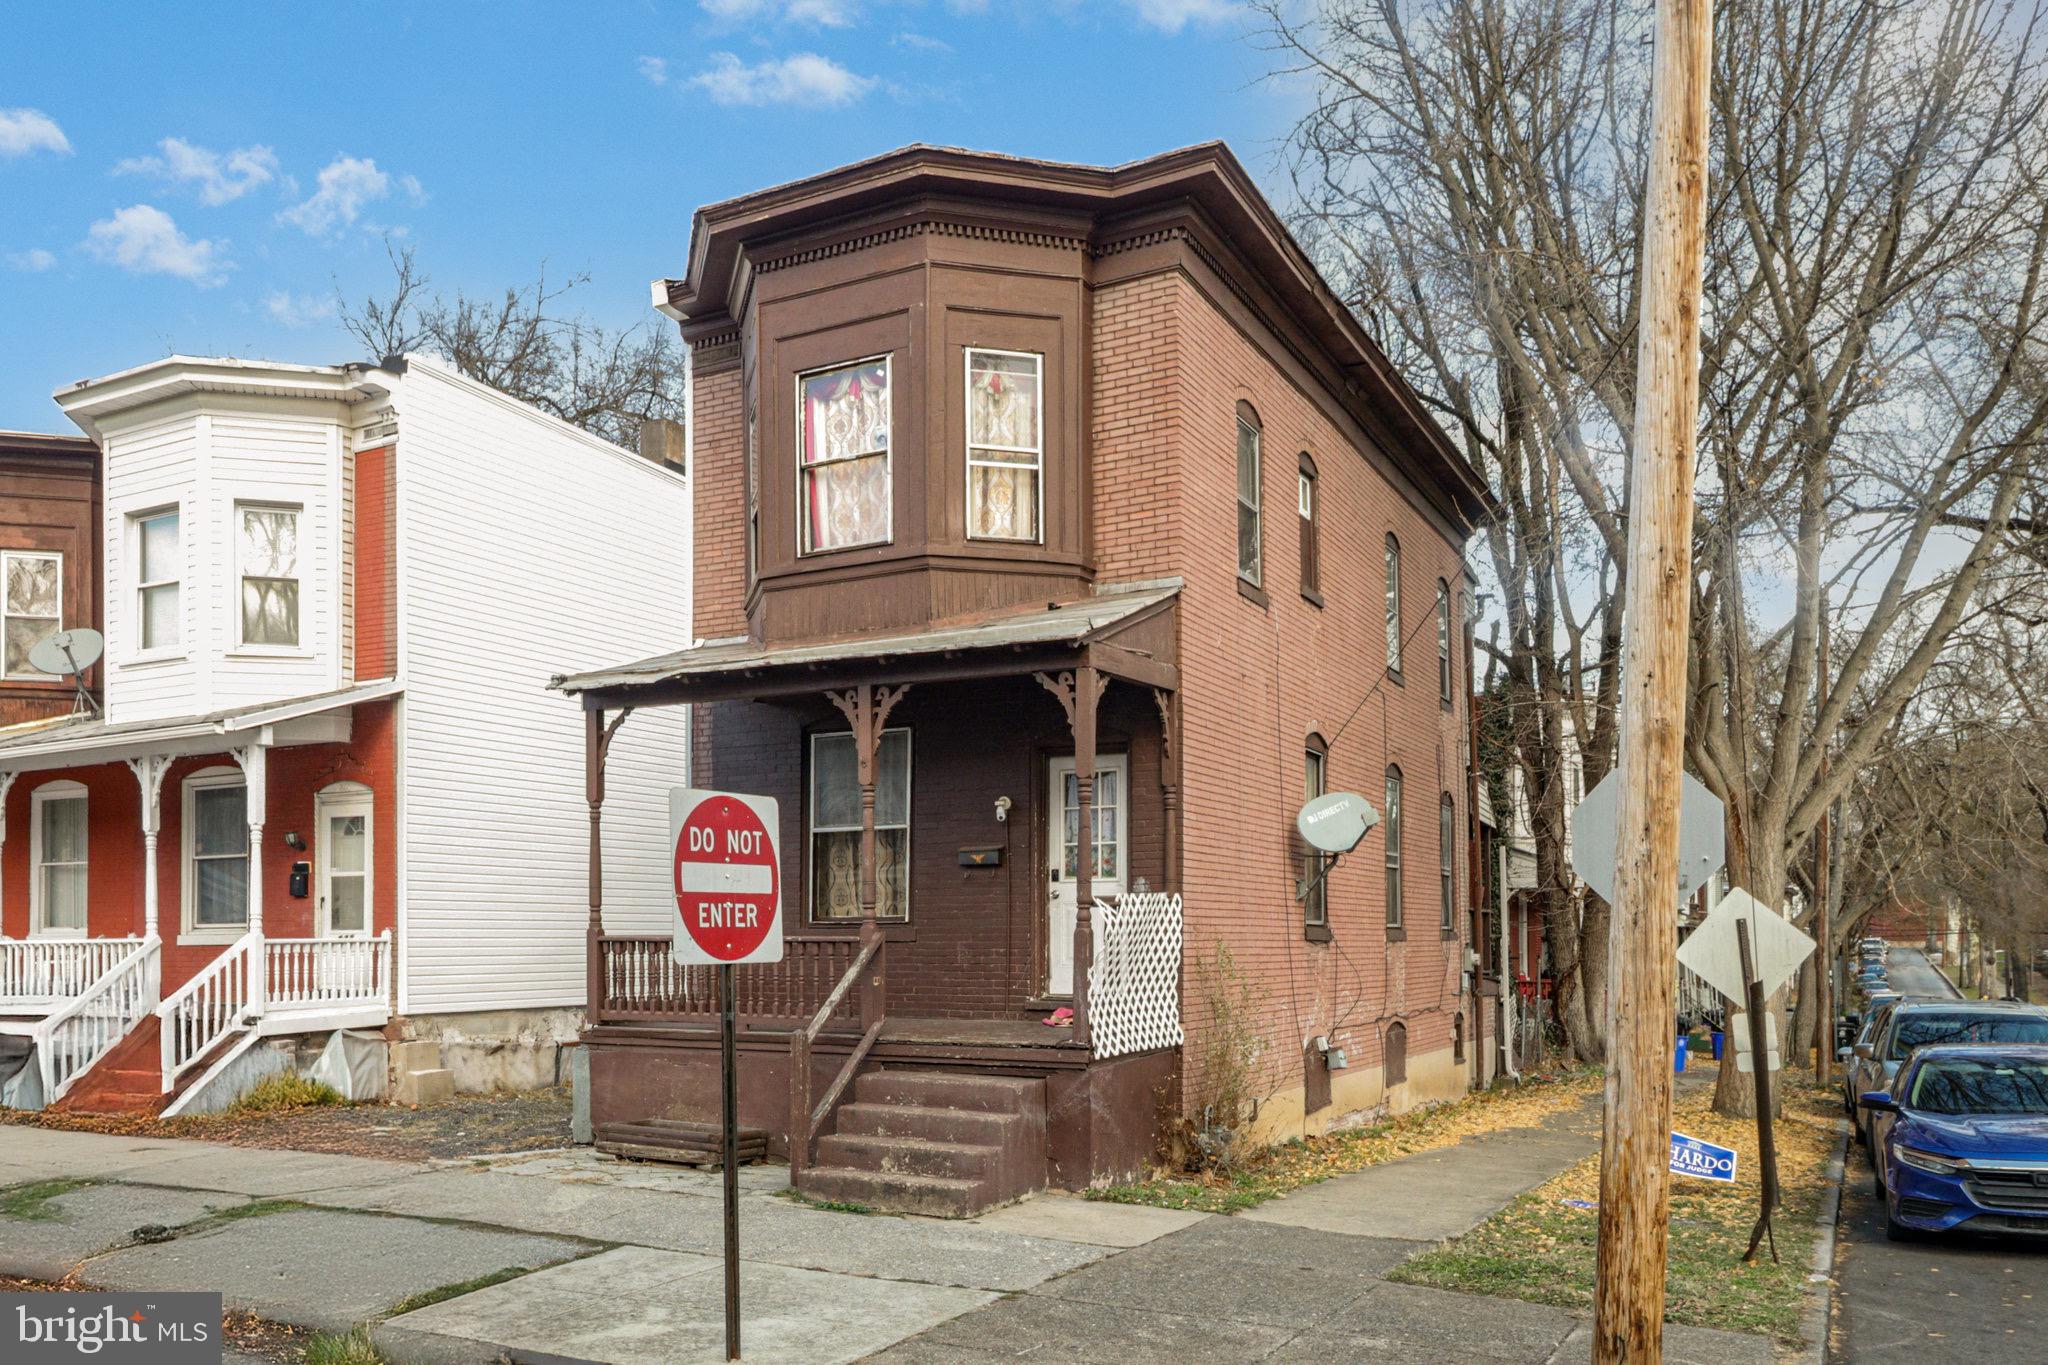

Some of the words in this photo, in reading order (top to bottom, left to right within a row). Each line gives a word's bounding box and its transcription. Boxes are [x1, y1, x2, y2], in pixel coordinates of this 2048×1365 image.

[1317, 800, 1349, 820] DIRECTV
[689, 826, 715, 853] DO
[727, 829, 762, 855] NOT
[698, 902, 758, 928] ENTER
[1686, 1164, 1713, 1174] JUDGE
